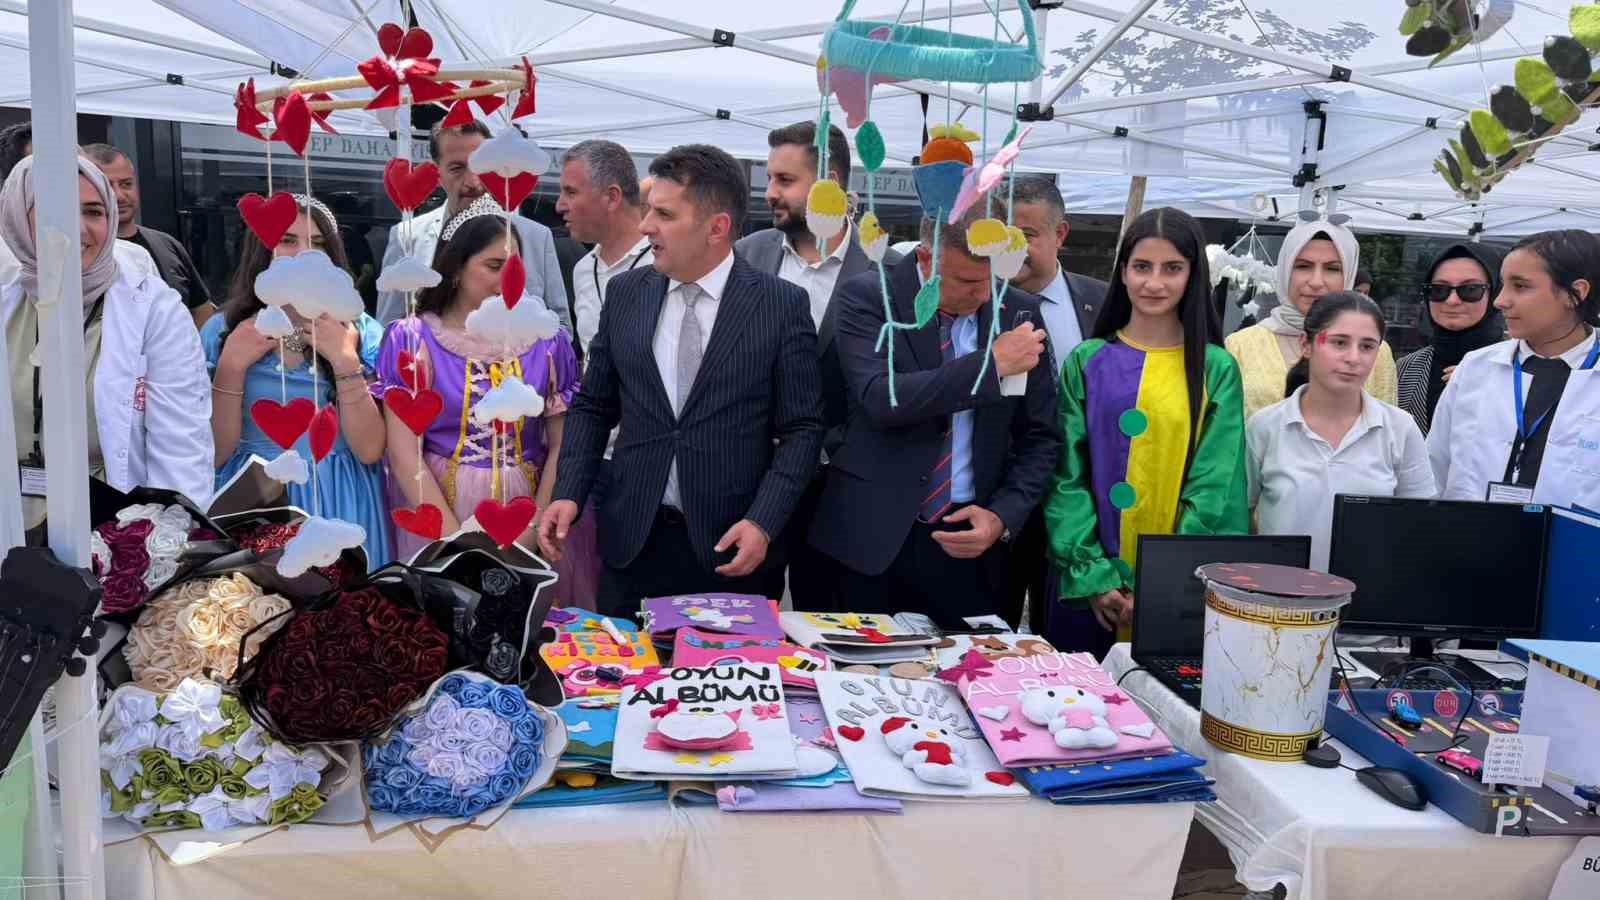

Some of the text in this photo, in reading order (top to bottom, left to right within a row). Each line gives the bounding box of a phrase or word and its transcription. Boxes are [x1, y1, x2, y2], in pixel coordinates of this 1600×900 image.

[311, 136, 332, 152] EP
[342, 138, 392, 156] DAHA
[670, 666, 770, 681] OYUN
[999, 652, 1104, 675] OYUN
[627, 683, 780, 706] ALBÜMÜ
[839, 677, 950, 708] OYUN
[1495, 805, 1522, 837] P
